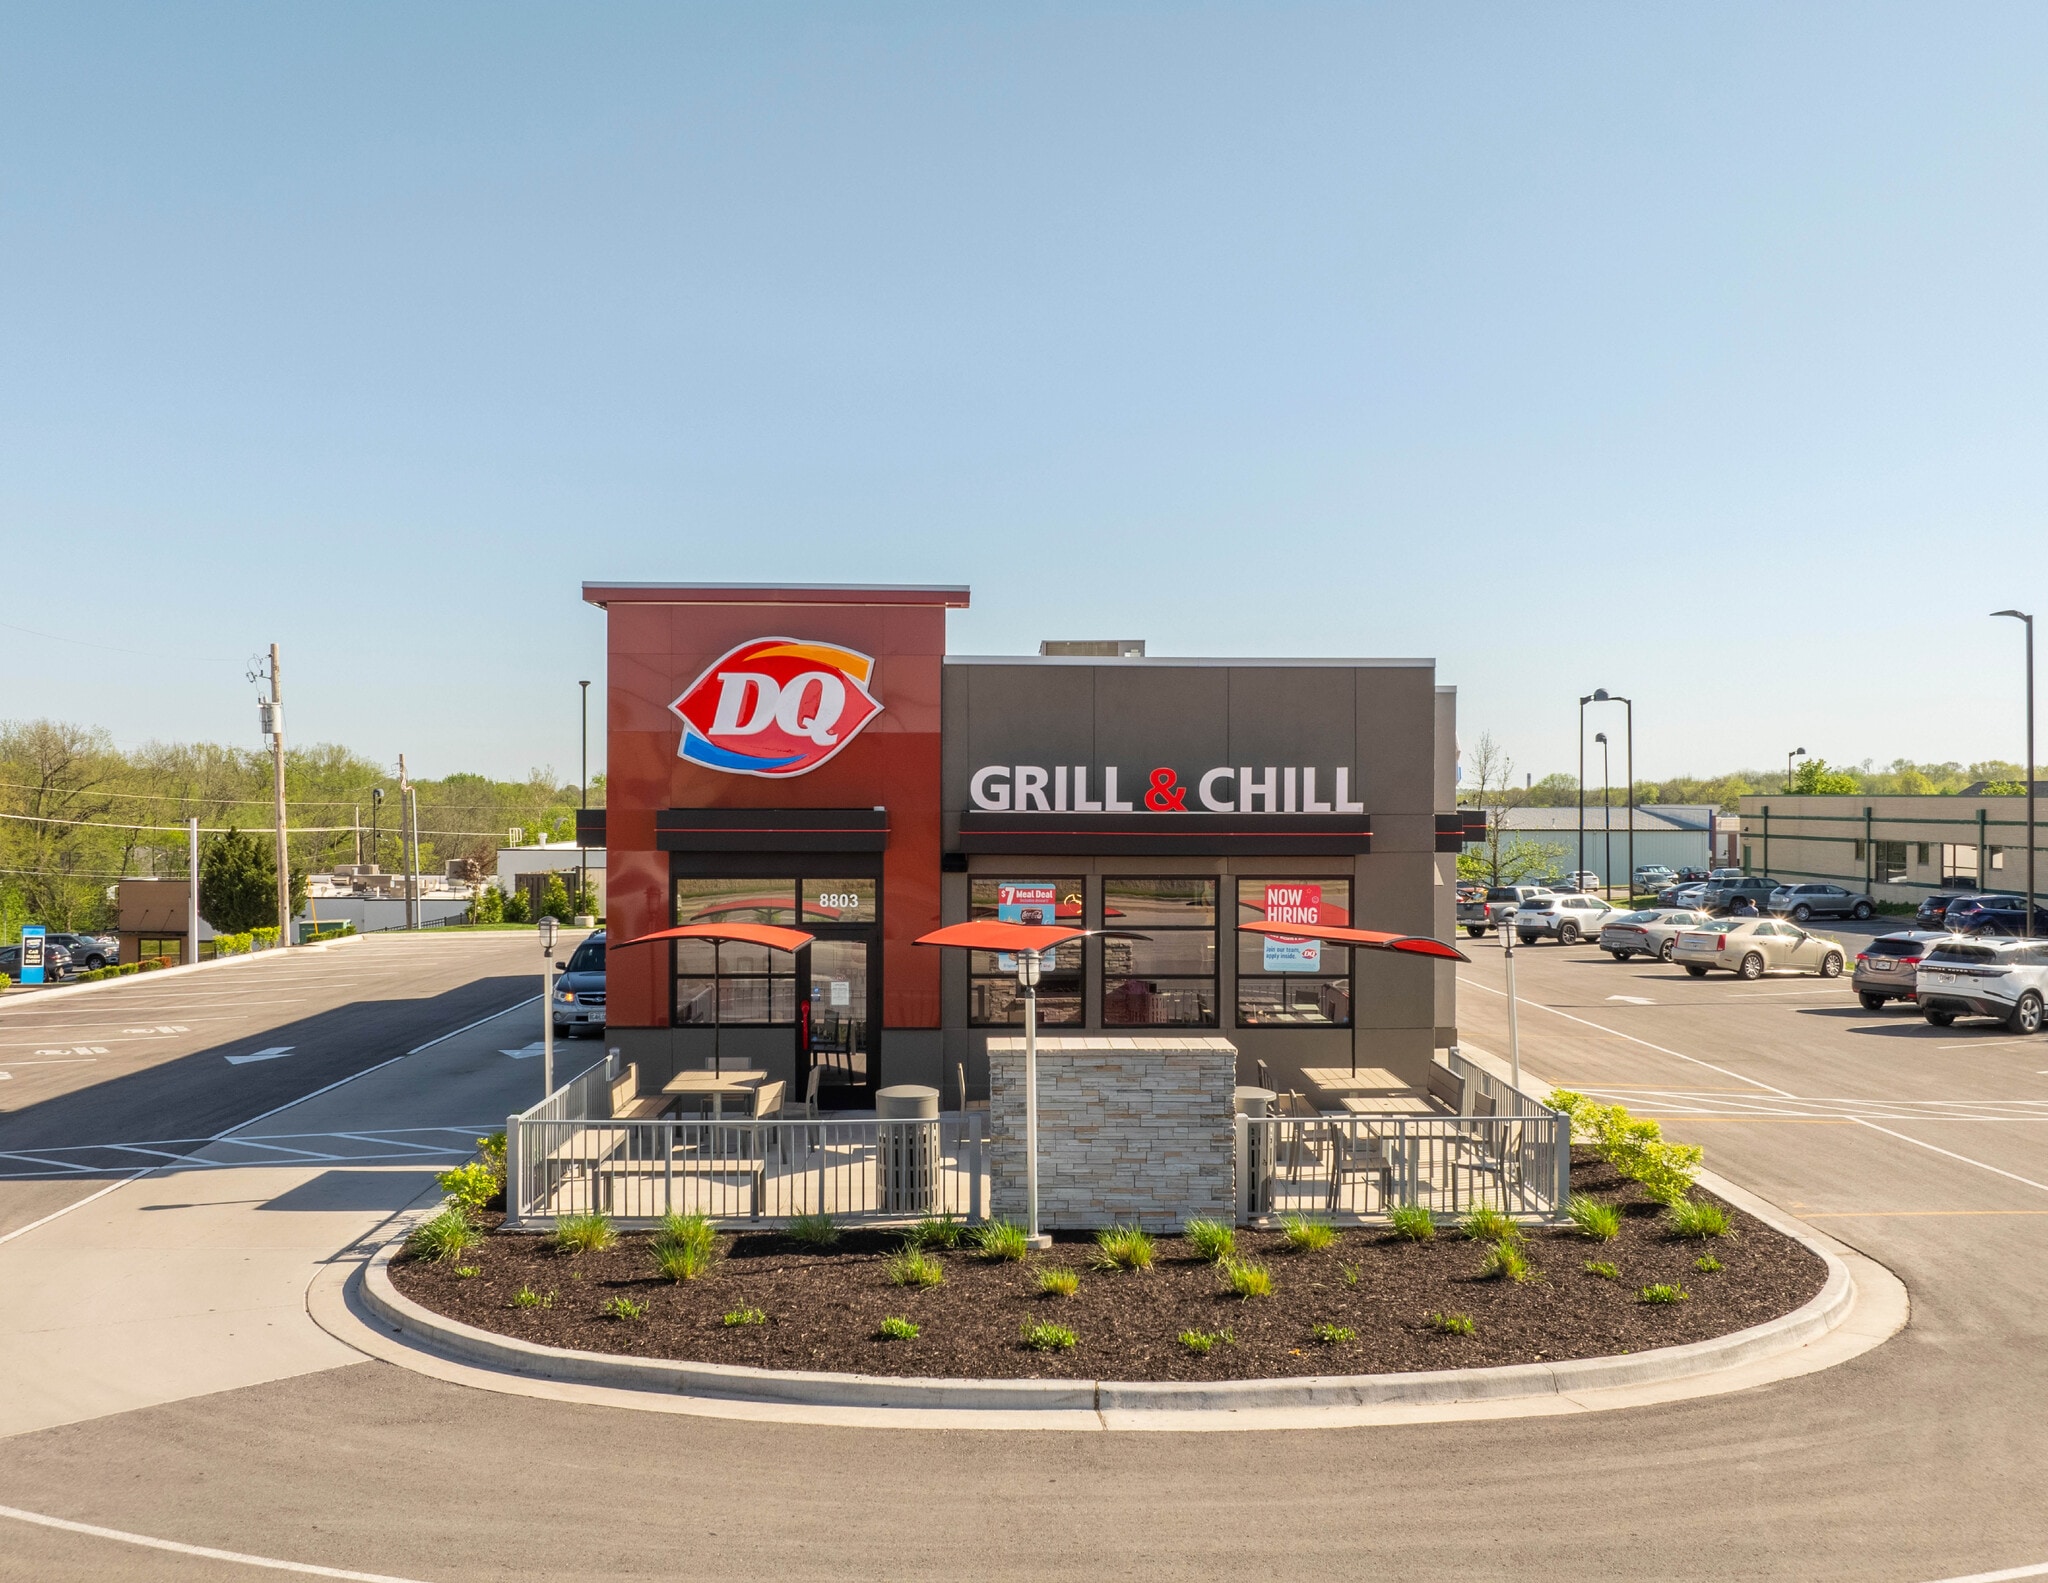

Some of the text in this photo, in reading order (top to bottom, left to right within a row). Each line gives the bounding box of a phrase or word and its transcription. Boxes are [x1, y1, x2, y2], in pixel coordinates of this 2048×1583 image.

[708, 671, 846, 747] DQ
[969, 765, 1364, 813] GRILL & CHILL
[819, 893, 859, 908] 8803
[1001, 886, 1053, 906] $7 Meal Deal
[1267, 888, 1303, 906] NOW
[1267, 906, 1318, 924] HIRING
